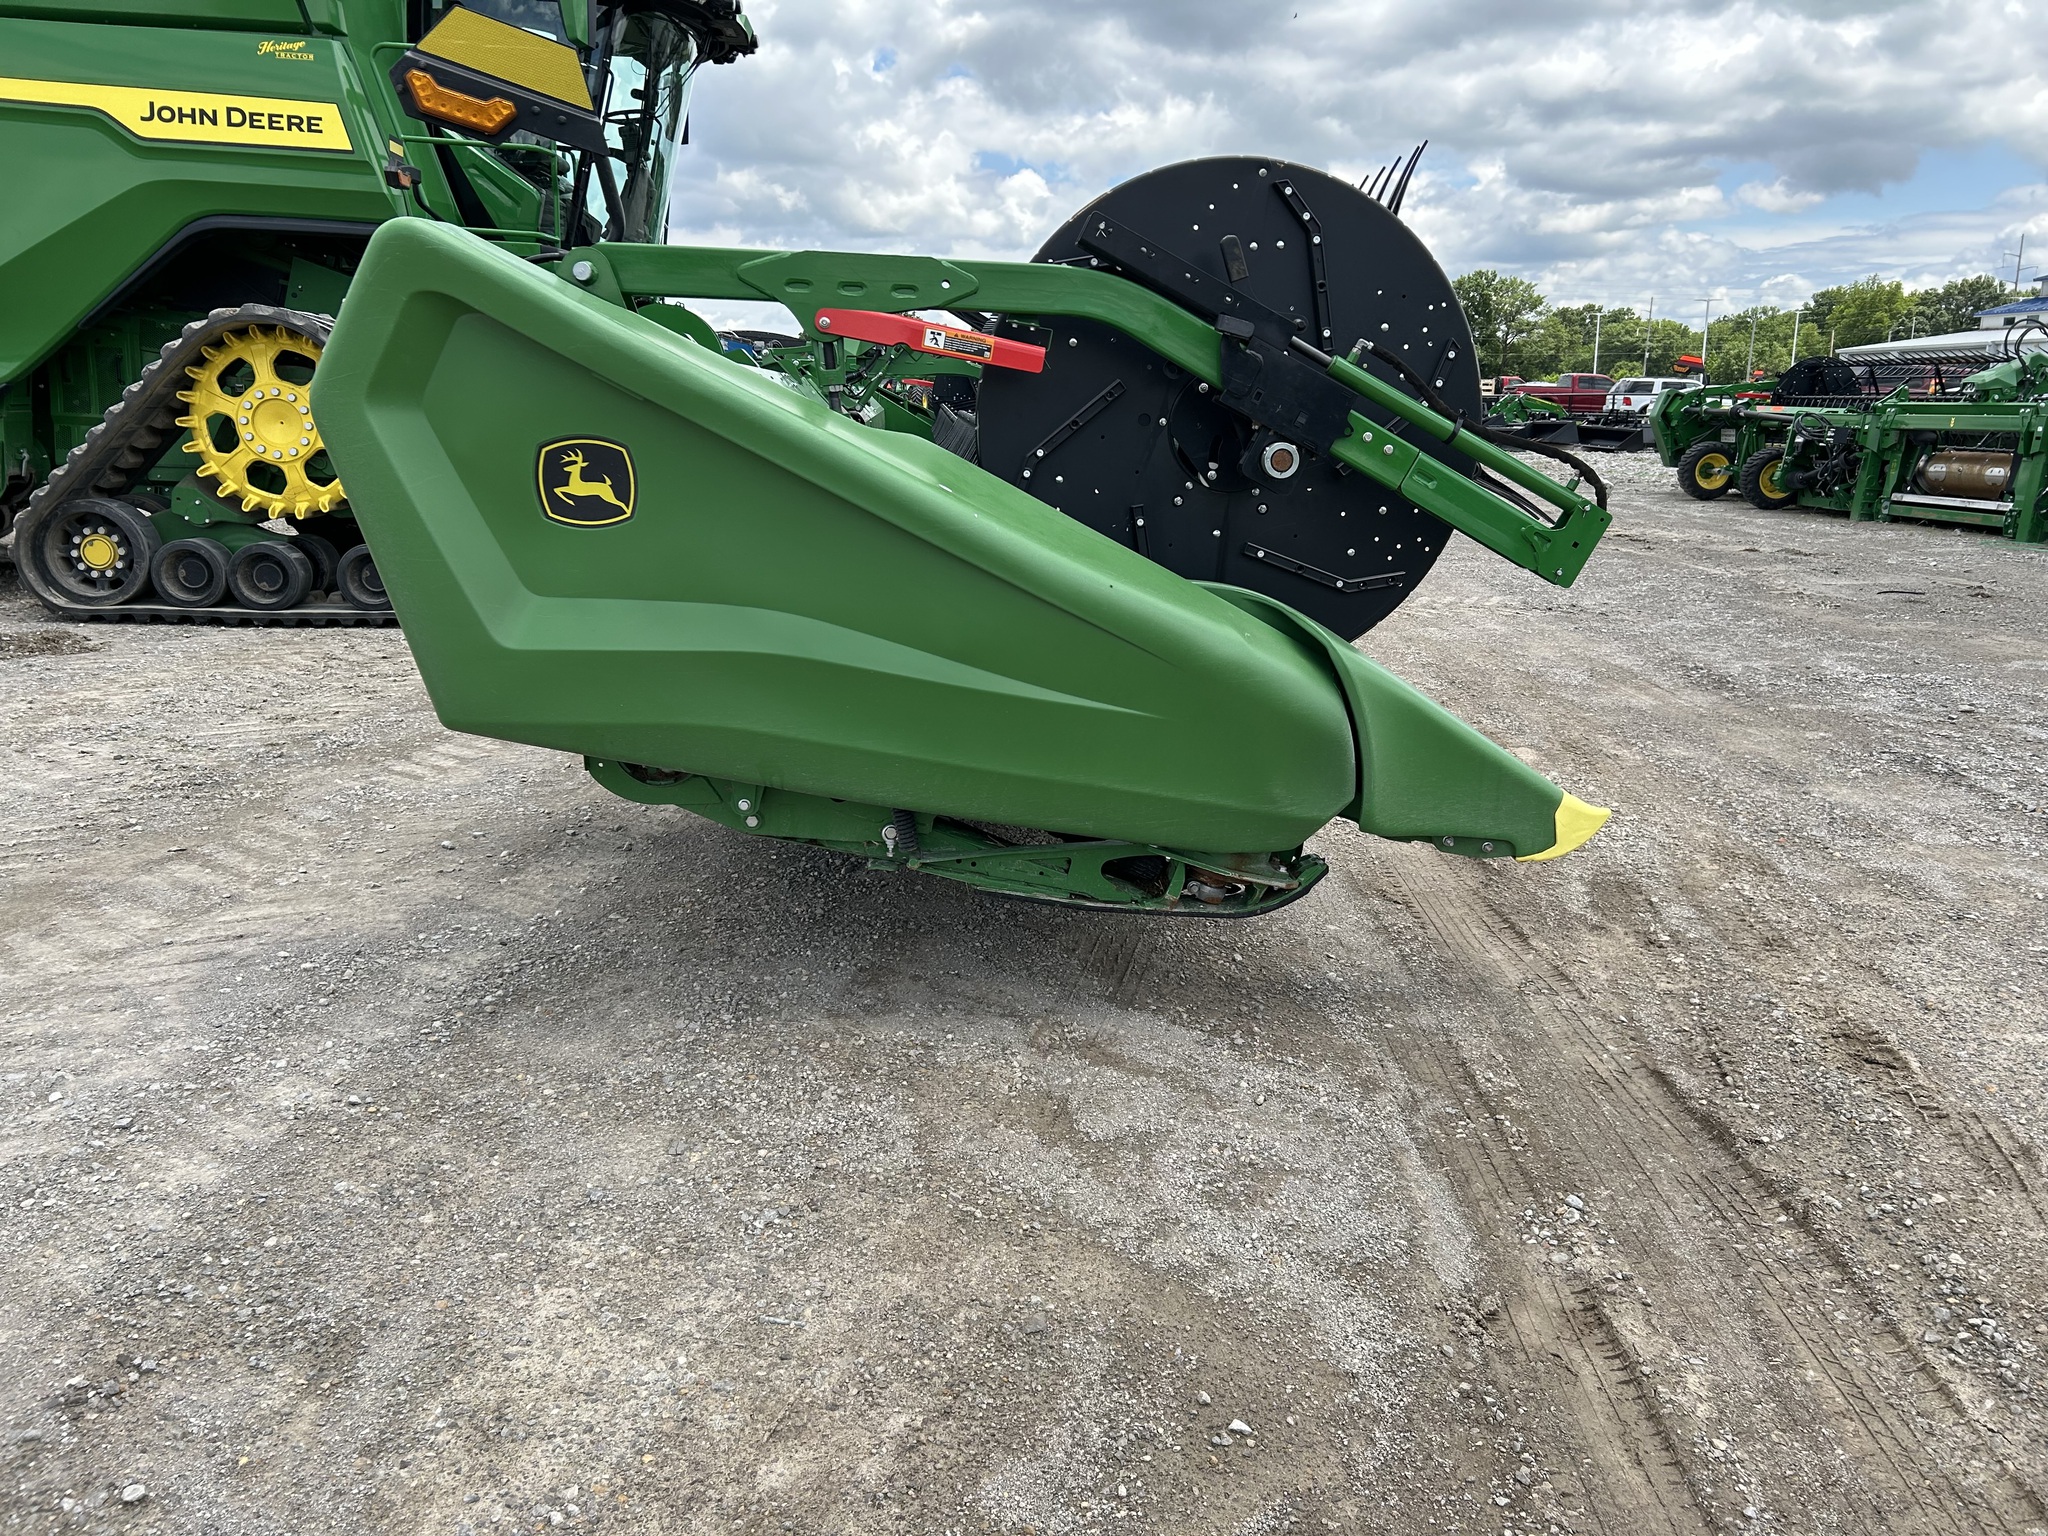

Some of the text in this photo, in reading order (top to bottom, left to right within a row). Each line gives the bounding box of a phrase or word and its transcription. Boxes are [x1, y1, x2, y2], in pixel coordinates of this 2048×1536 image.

[257, 40, 306, 55] Heritage
[275, 51, 314, 61] TRACTOR
[140, 101, 323, 133] JOHN DEERE
[960, 333, 987, 343] WARNING
